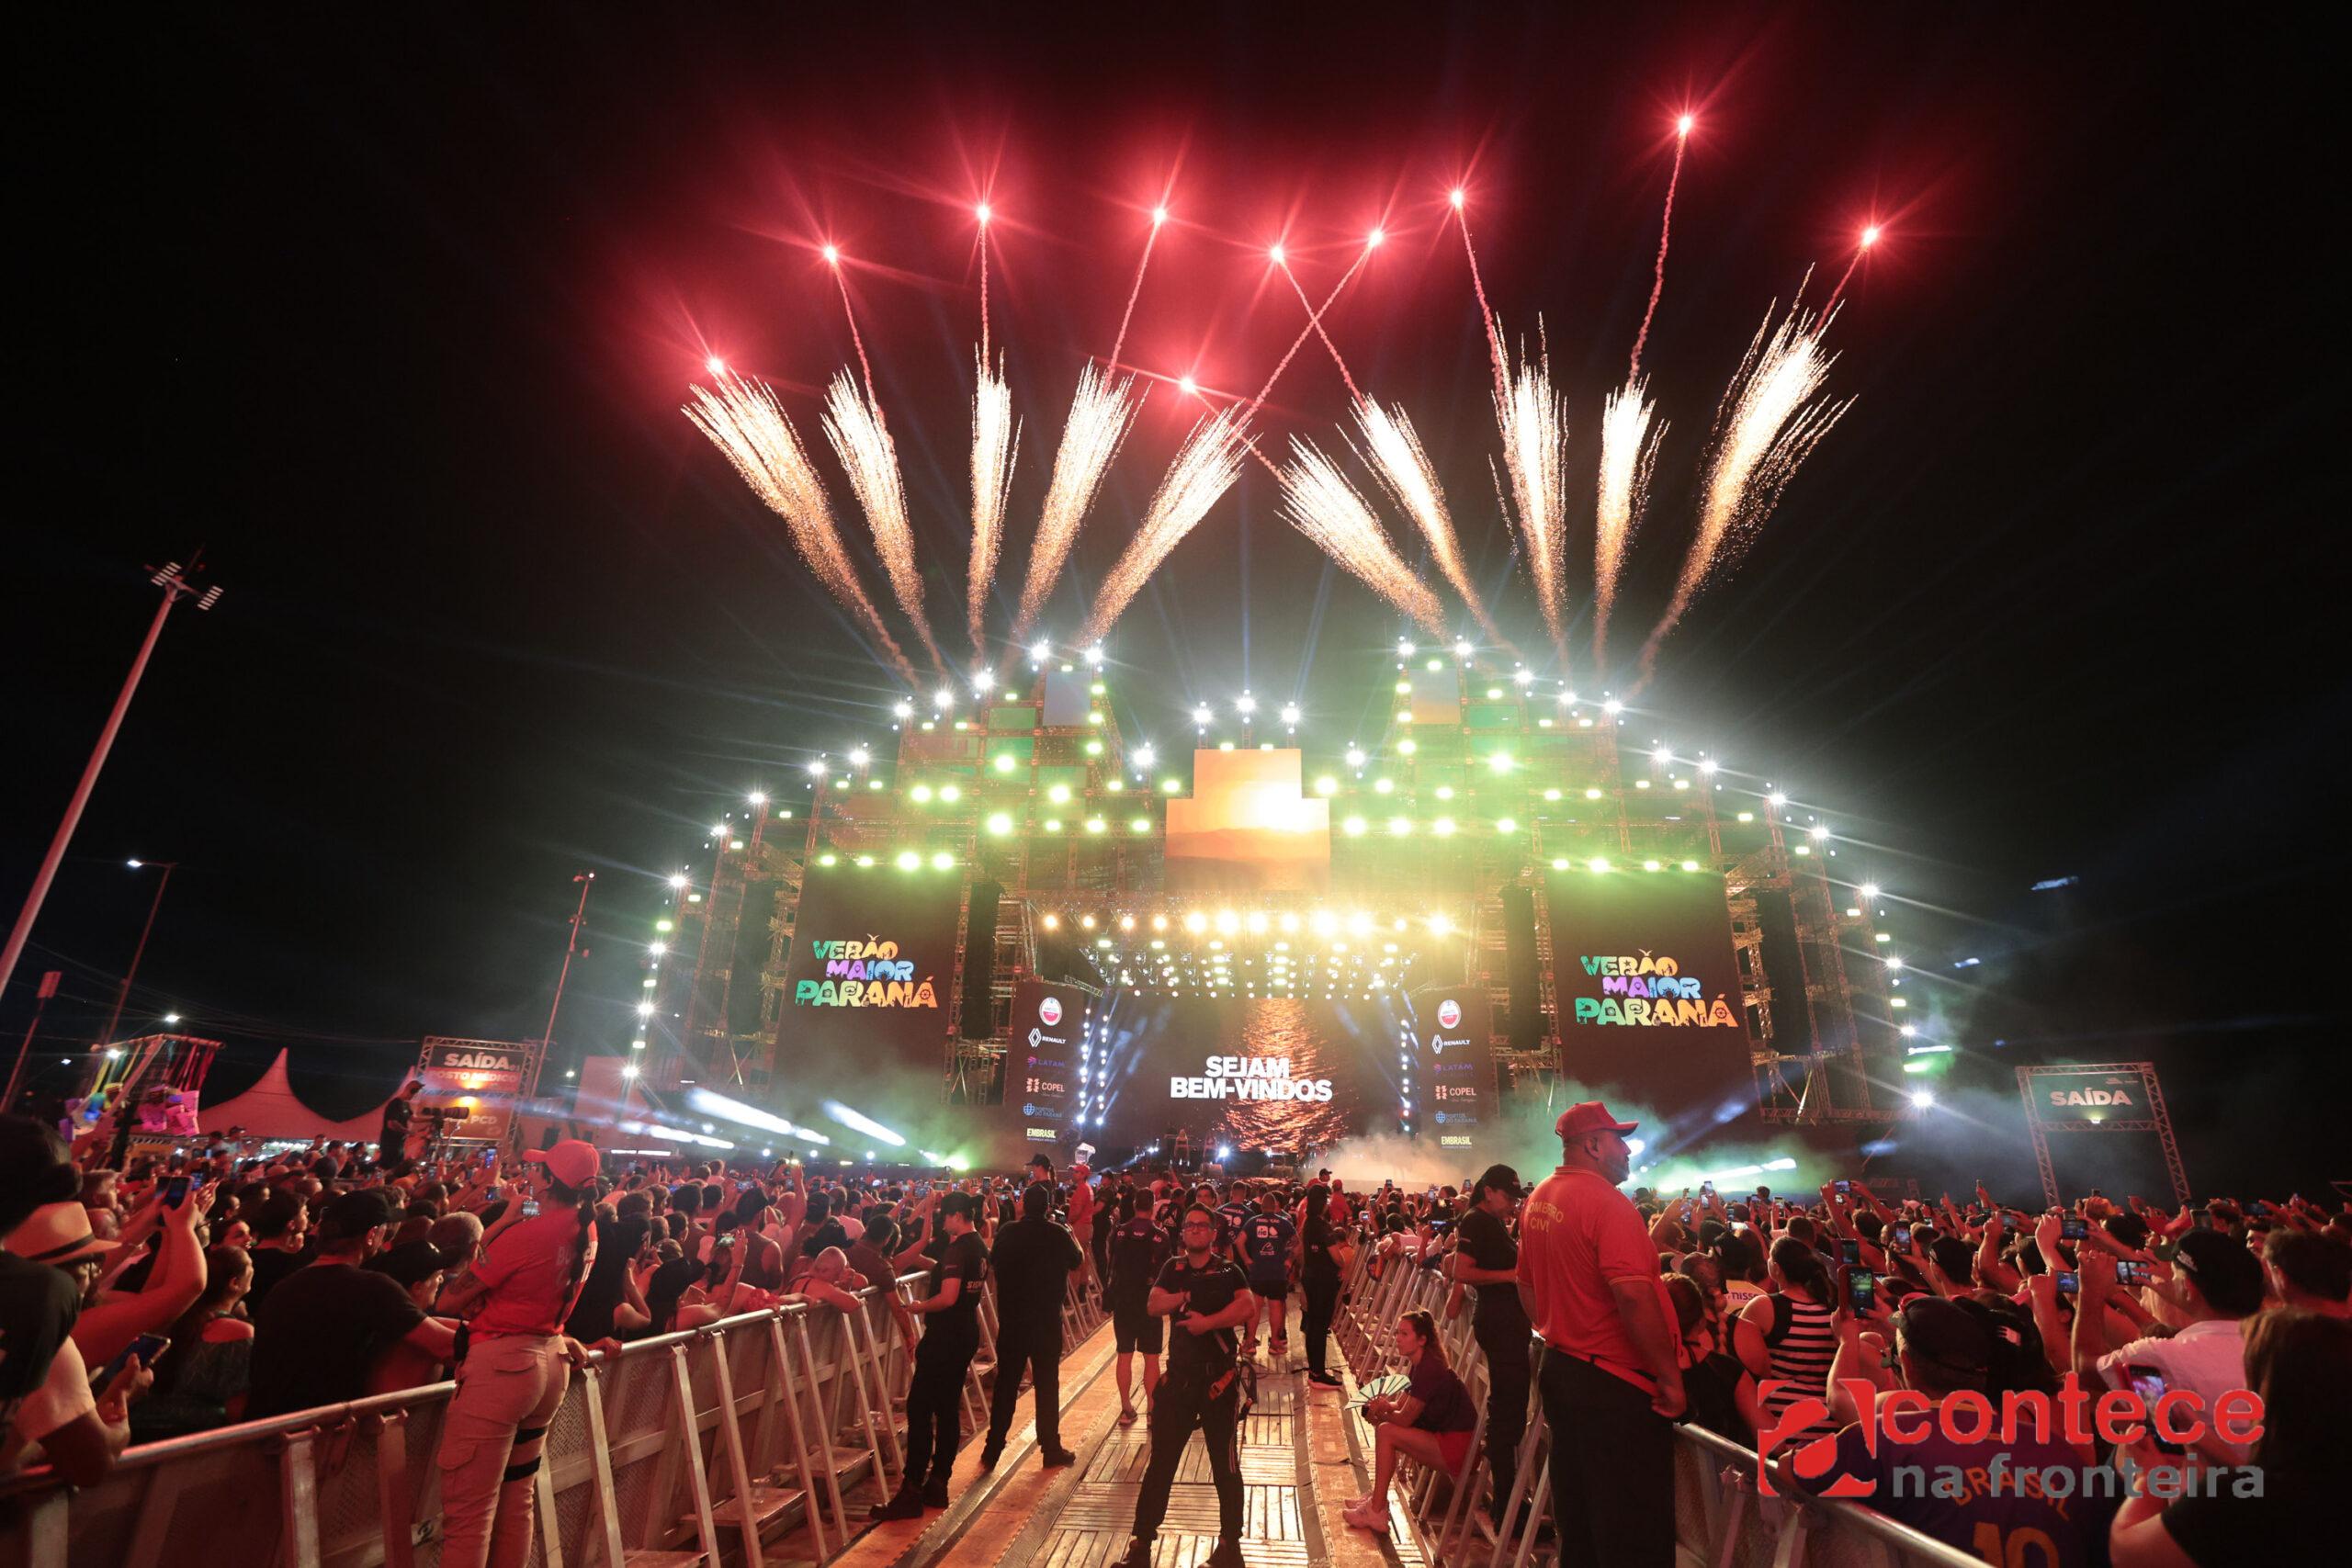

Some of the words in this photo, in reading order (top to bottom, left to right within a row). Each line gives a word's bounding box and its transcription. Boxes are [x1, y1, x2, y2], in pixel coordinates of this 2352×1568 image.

[813, 933, 899, 960] VERÃO
[825, 960, 914, 981] MAIOR
[1580, 949, 1678, 976] VERÃO
[795, 976, 938, 1009] PARANÁ
[1602, 976, 1702, 999] MAIOR
[1575, 993, 1738, 1028] PARANÁ
[1042, 1035, 1067, 1044] RENAULT
[444, 1052, 510, 1070] SAÍDA
[1204, 1055, 1291, 1079] SEJAM
[1442, 1063, 1474, 1071] LATAM
[1041, 1082, 1066, 1092] COPEL
[1170, 1077, 1333, 1102] BEM-VINDOS
[1449, 1087, 1477, 1096] COPEL
[2049, 1087, 2132, 1106] SAÍDA
[1026, 1127, 1057, 1139] EMBRASIL
[1441, 1135, 1473, 1145] EMBRASIL
